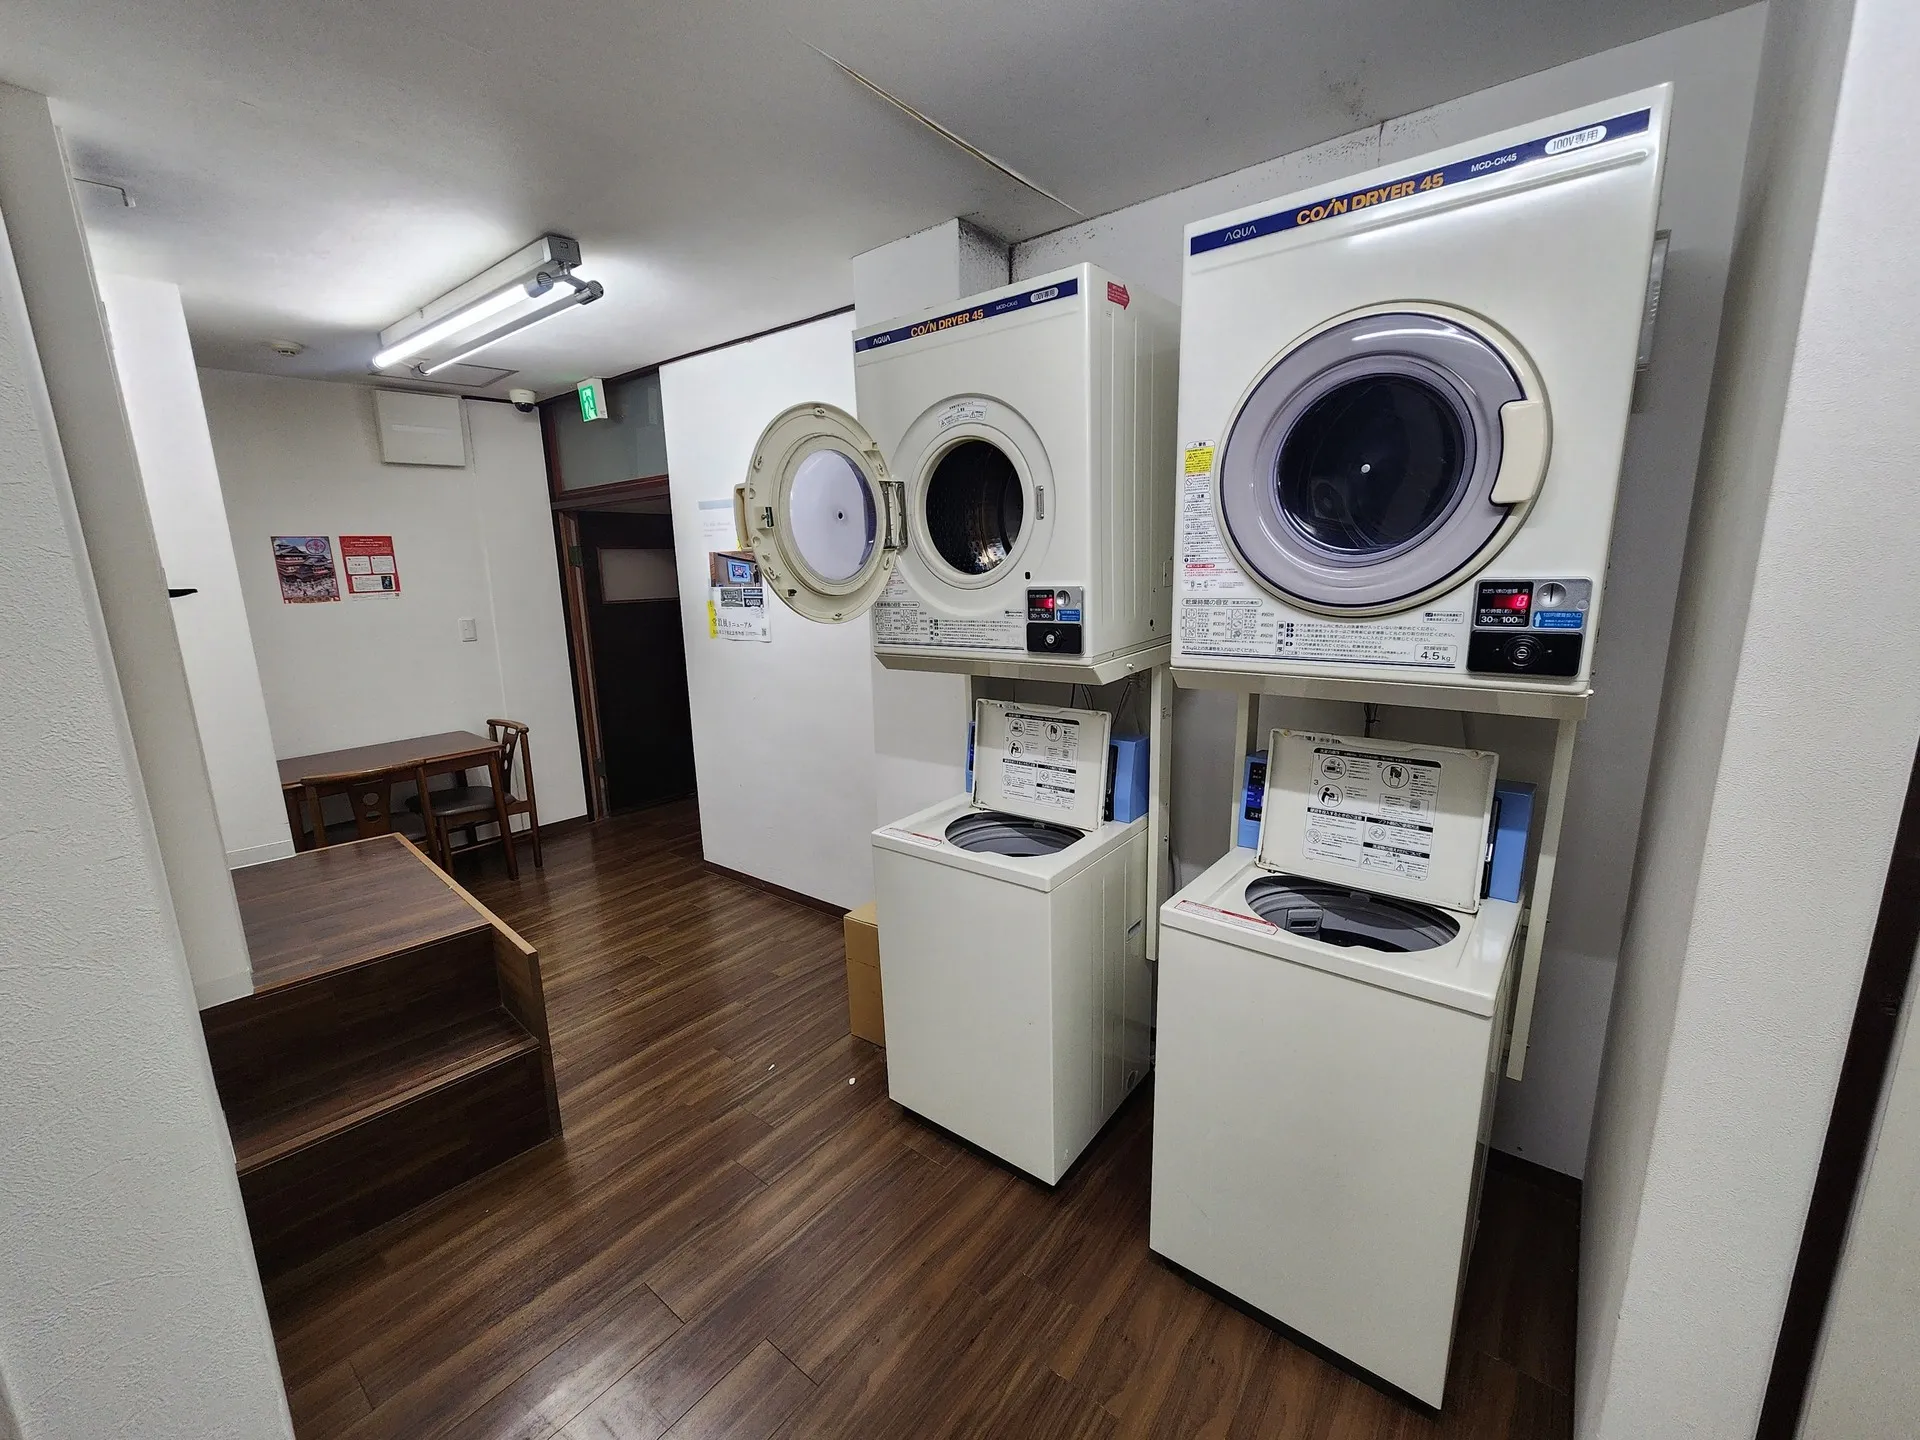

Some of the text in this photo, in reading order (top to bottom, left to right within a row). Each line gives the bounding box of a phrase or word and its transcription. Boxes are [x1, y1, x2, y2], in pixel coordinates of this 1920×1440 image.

[1551, 129, 1600, 152] 100V専用
[1470, 153, 1518, 174] MCD-CK45
[1224, 225, 1257, 243] AQUA
[1350, 180, 1416, 212] DRYER
[1420, 171, 1445, 193] 45
[872, 334, 891, 346] AQUA
[938, 312, 970, 331] DRYER
[972, 308, 984, 322] 45
[1420, 651, 1440, 660] 4.5
